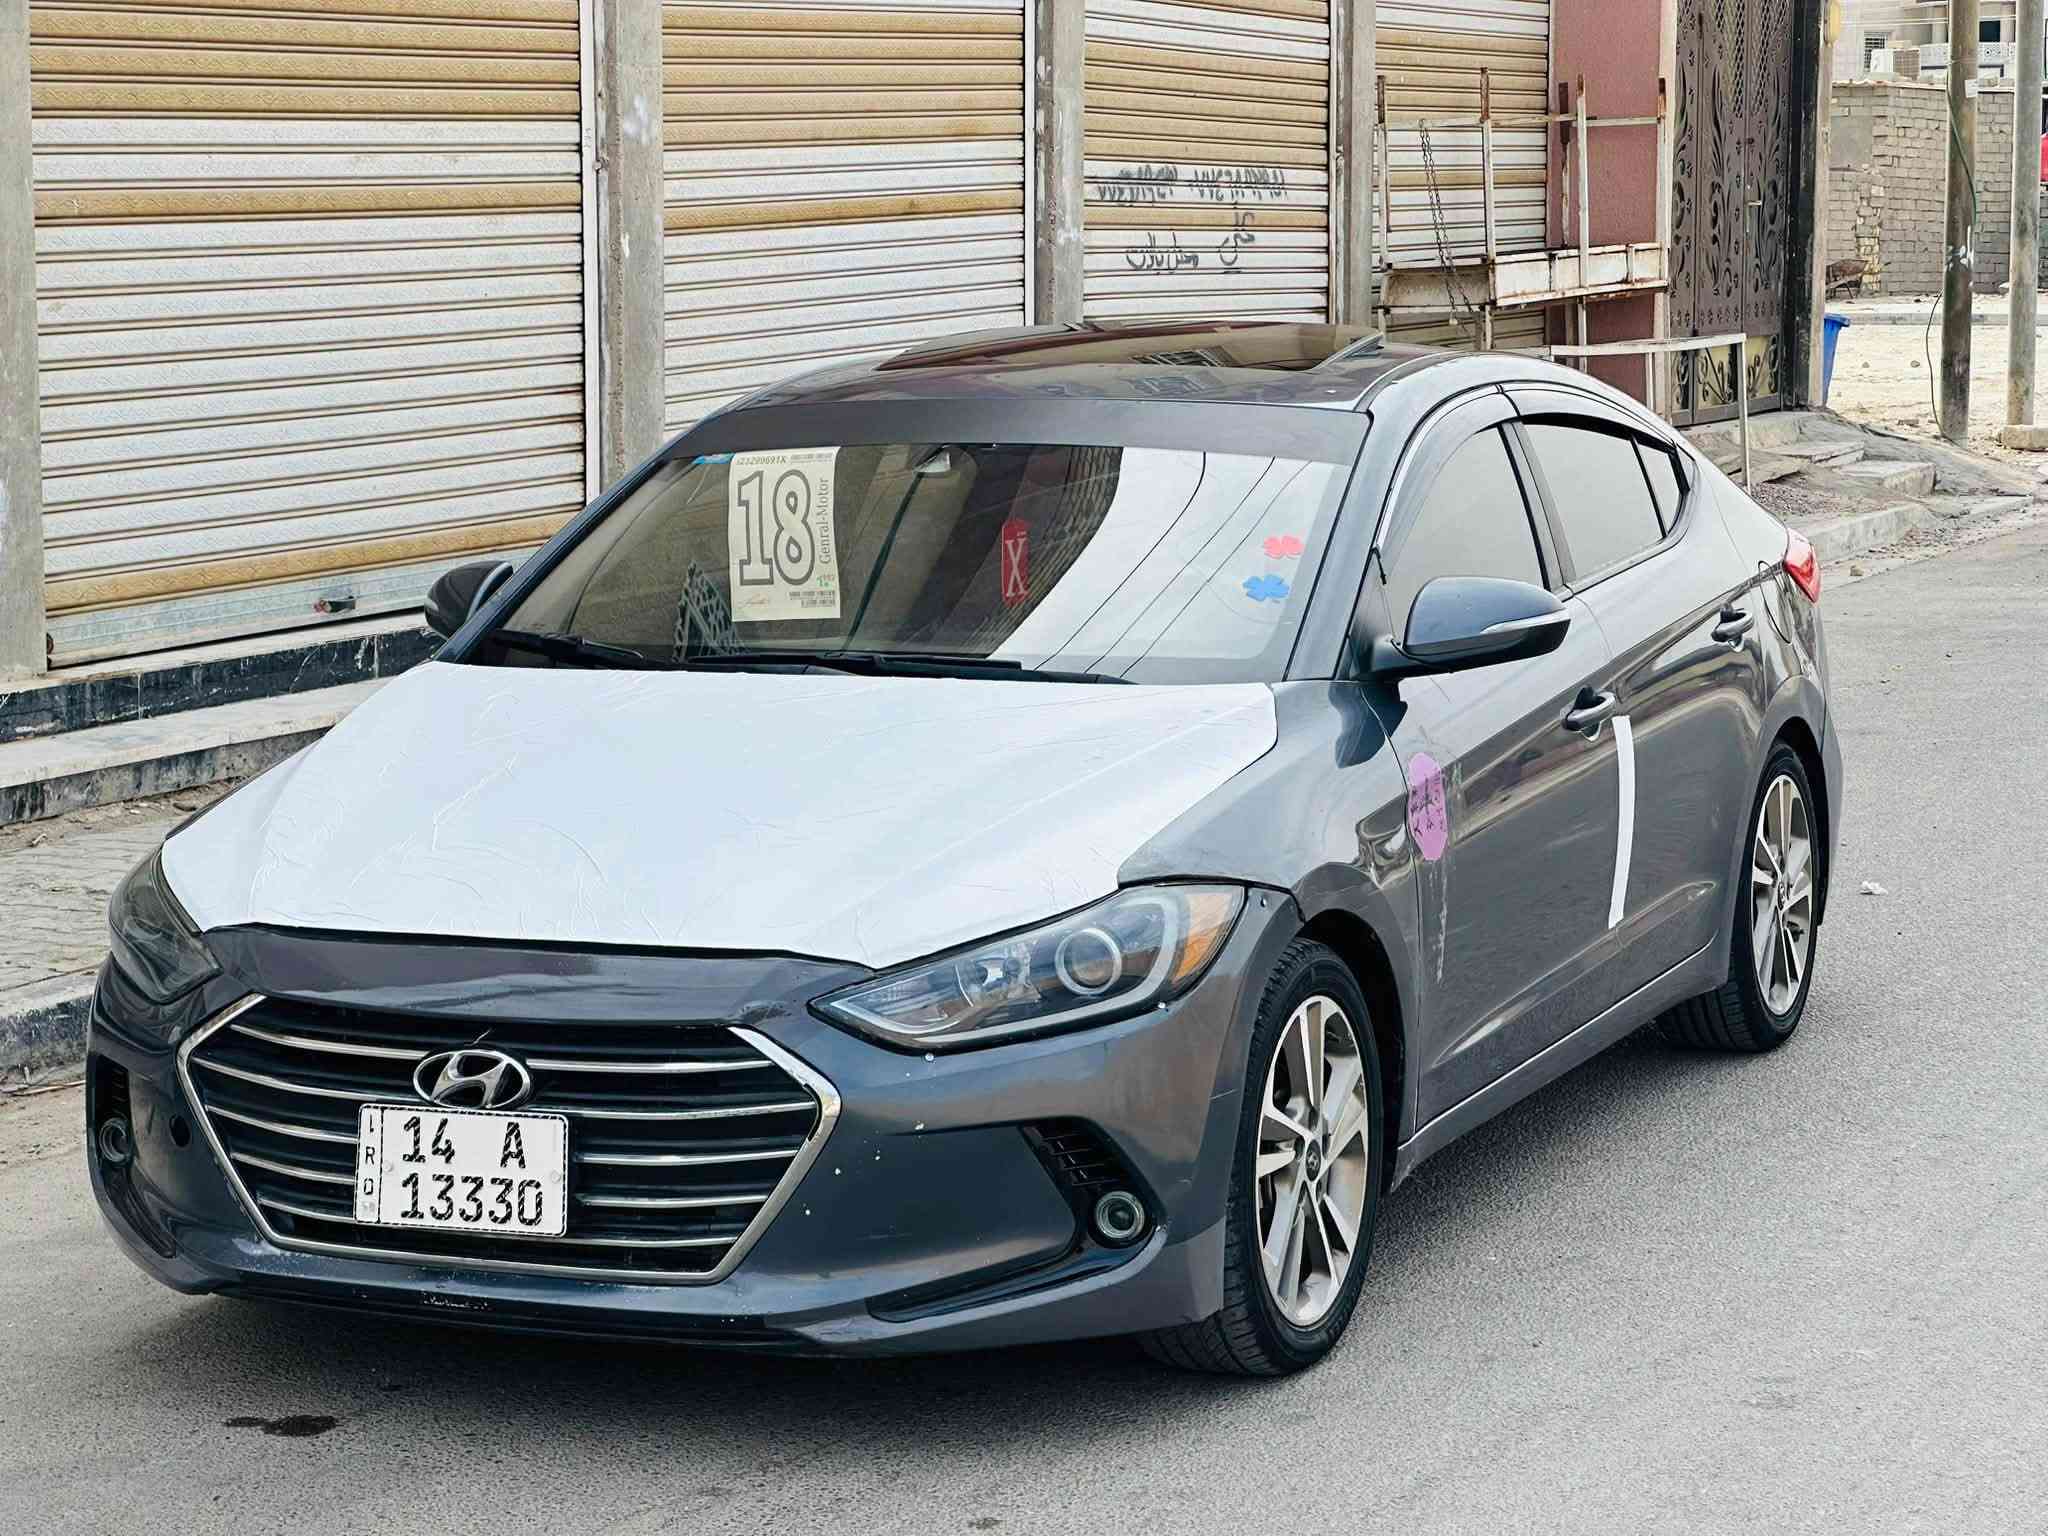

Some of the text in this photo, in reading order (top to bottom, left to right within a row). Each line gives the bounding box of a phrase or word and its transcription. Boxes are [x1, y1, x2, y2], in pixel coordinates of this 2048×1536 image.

[737, 468, 815, 586] 18
[402, 1115, 526, 1169] 14 A
[400, 1172, 544, 1226] 13330
